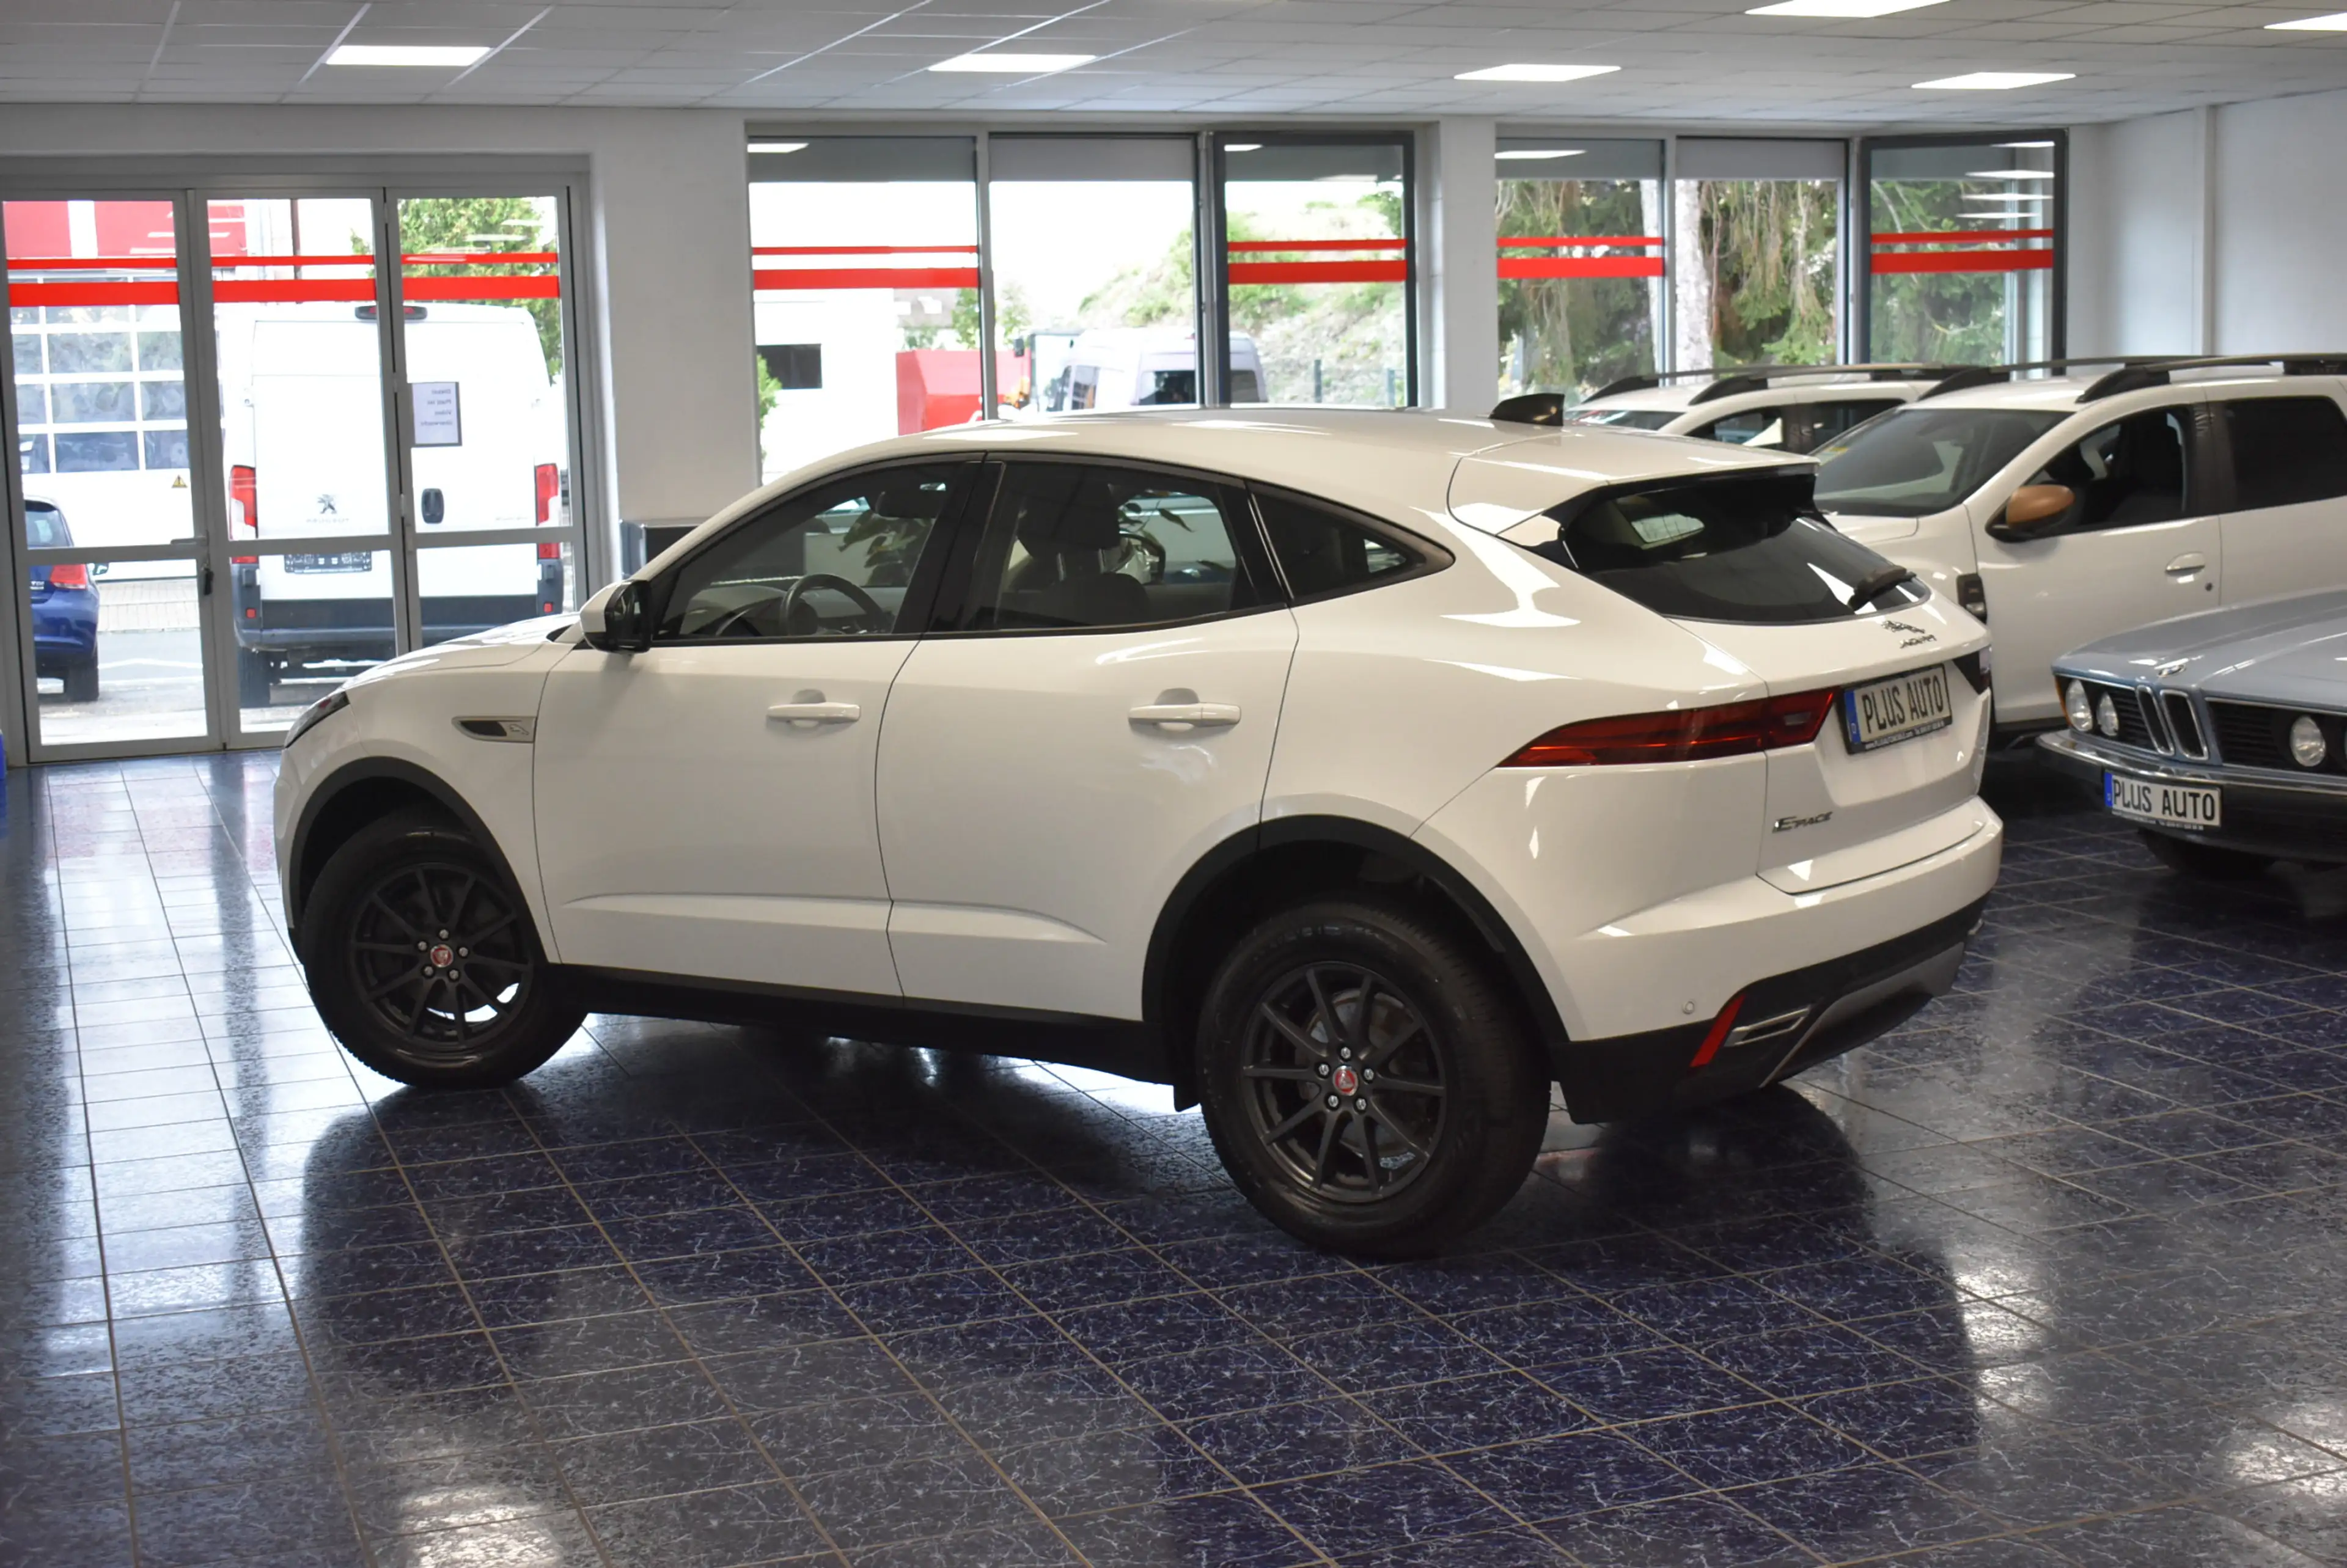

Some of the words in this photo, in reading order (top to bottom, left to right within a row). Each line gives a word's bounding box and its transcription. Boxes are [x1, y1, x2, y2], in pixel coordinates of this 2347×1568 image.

[1862, 686, 1905, 734] PLUS
[1907, 675, 1944, 720] AUTO
[2114, 780, 2152, 812] PLUS
[2162, 789, 2215, 821] AUTO
